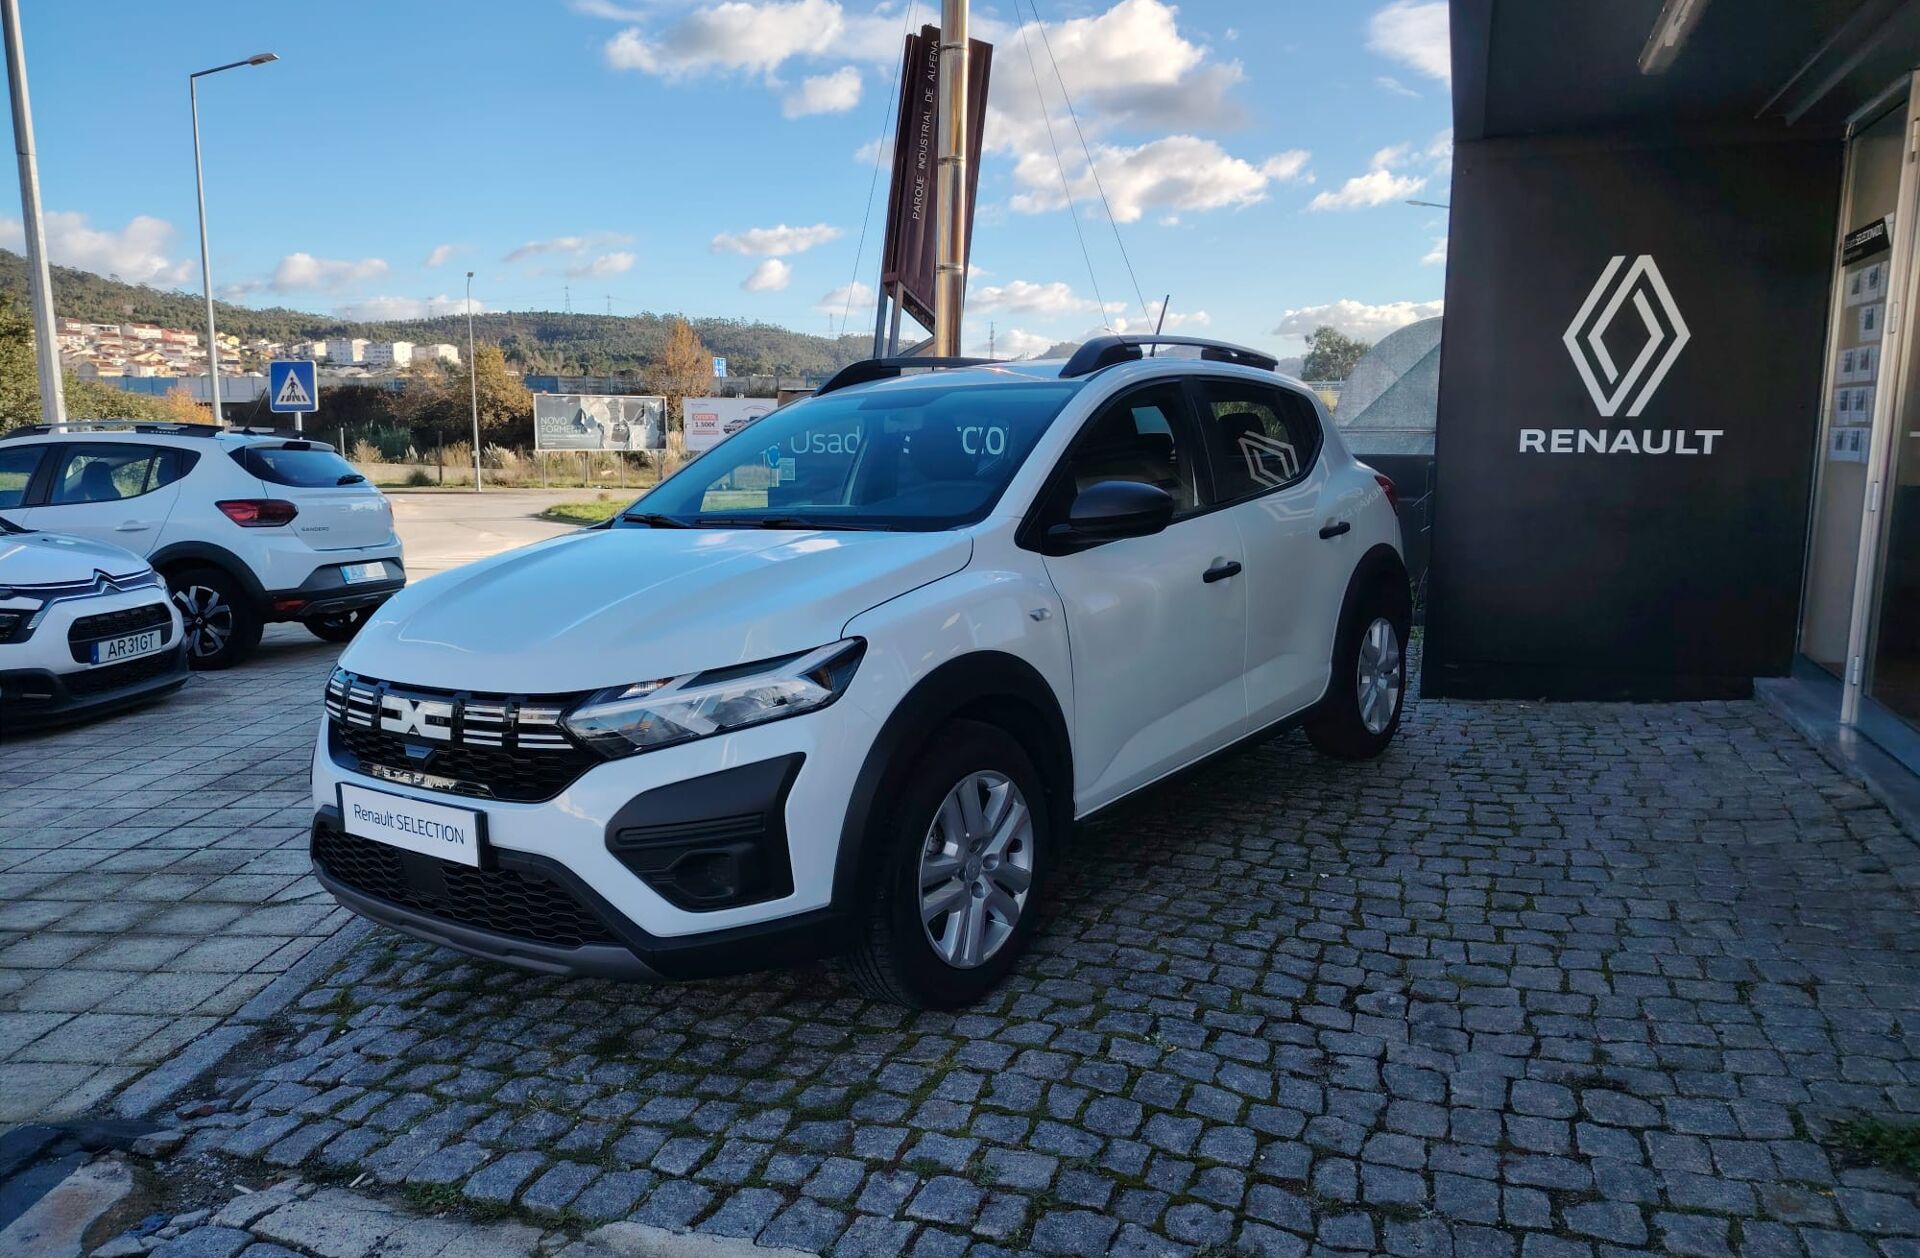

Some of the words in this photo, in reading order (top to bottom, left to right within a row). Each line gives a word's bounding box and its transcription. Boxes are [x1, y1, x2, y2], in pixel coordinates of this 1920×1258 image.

[928, 40, 940, 82] ALFENA
[925, 88, 934, 103] DE
[917, 109, 932, 170] INDUSTRIAL
[912, 175, 925, 220] PARQUE
[540, 416, 568, 426] NOVO
[1519, 428, 1725, 455] RENAULT
[107, 632, 155, 659] AR31GT
[383, 768, 456, 791] STEPWAY
[353, 803, 395, 829] Renault
[396, 815, 465, 845] SELECTION
